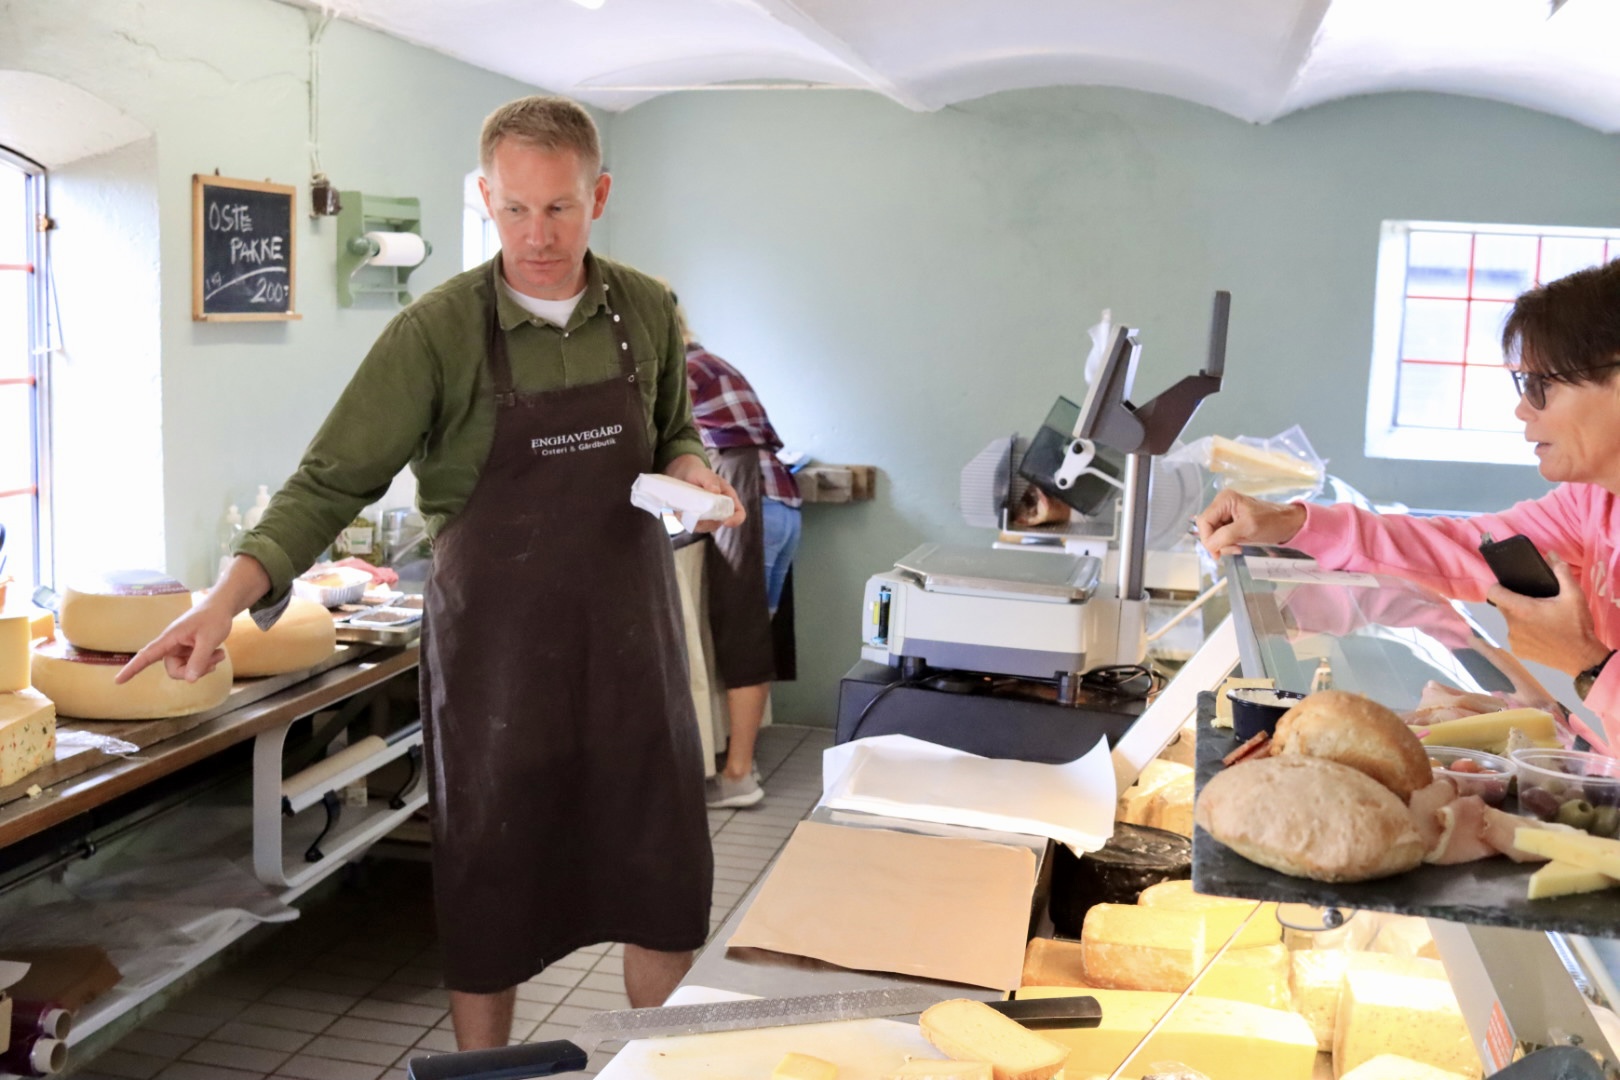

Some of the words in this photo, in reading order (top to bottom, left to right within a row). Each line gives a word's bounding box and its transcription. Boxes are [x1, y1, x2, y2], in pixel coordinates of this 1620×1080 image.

[209, 202, 253, 232] OSTE
[230, 236, 283, 264] PAKKE
[531, 424, 622, 449] ENGHAVEGÅRD
[541, 447, 567, 456] Osteri
[578, 438, 616, 450] Gårdbutik
